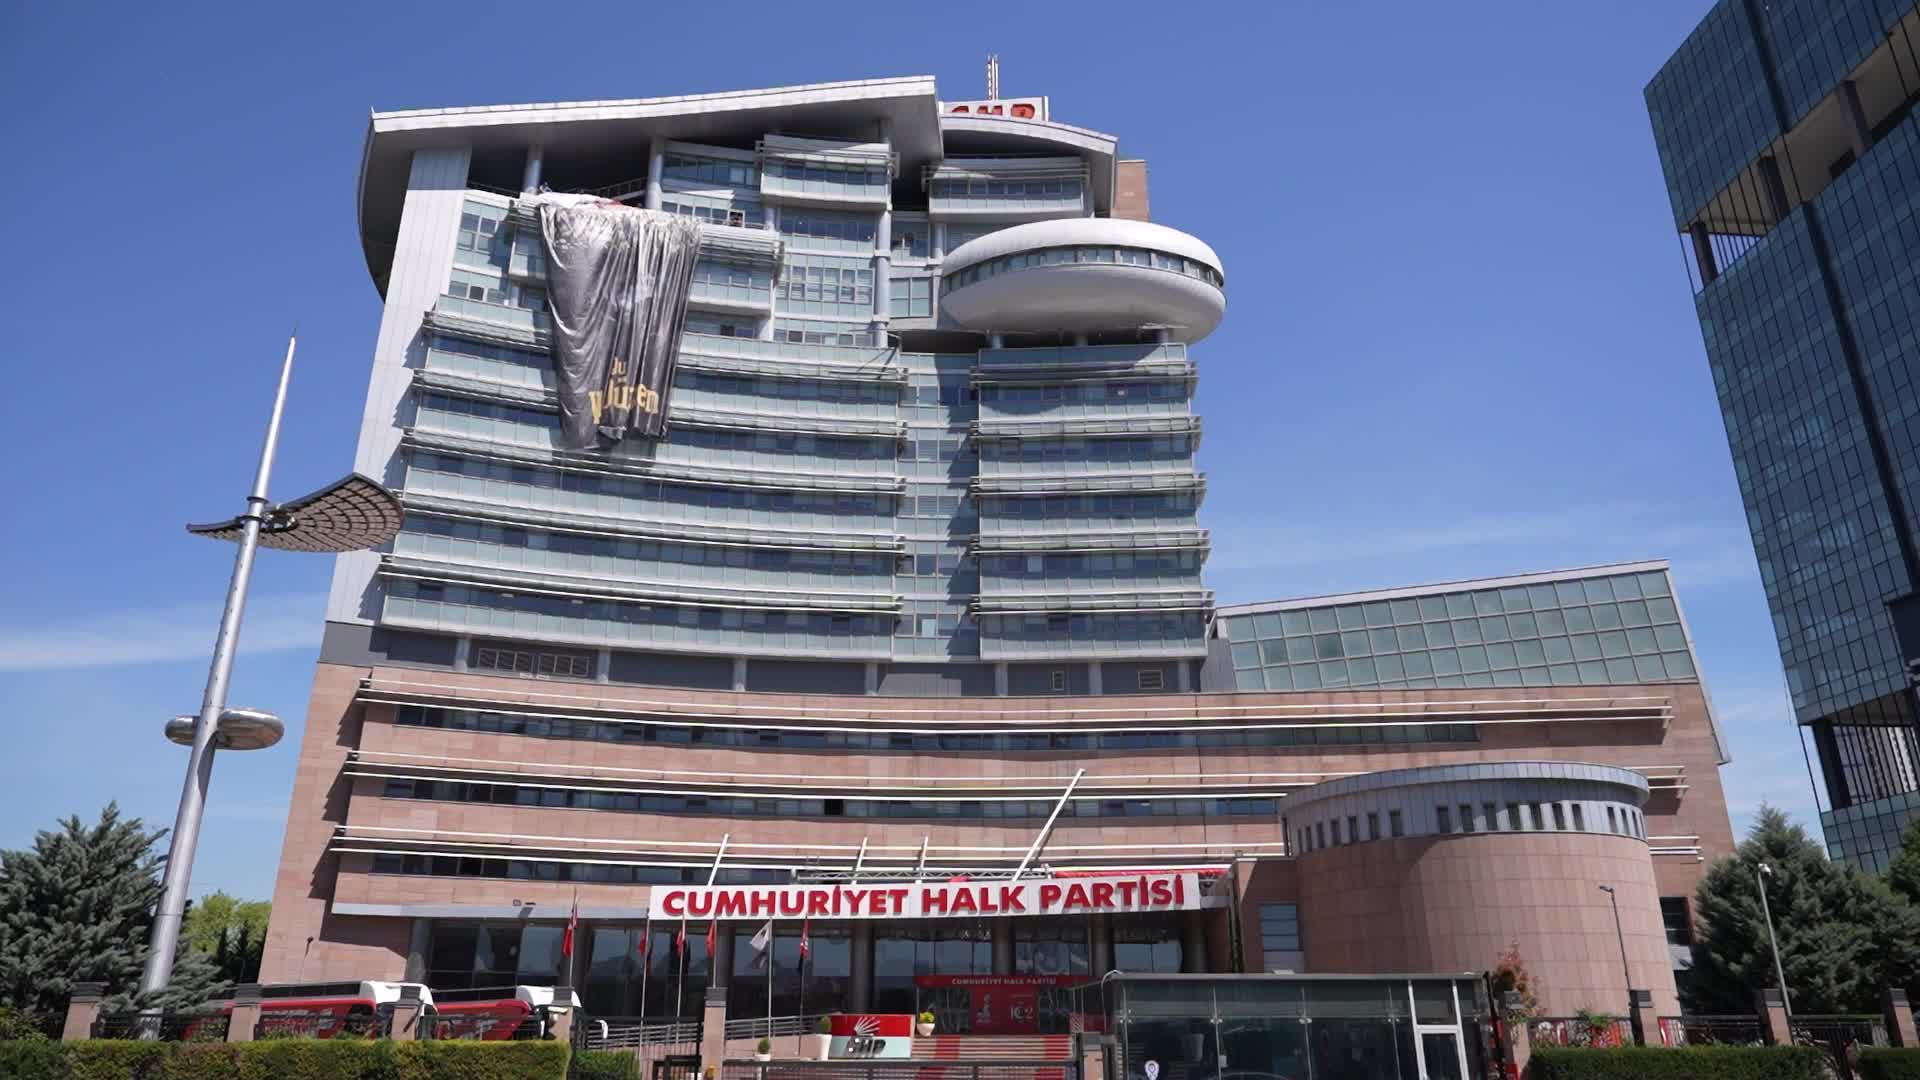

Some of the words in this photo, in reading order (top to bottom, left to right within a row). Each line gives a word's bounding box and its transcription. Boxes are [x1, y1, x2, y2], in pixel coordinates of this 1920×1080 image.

[663, 885, 909, 918] CUMHURİYET
[922, 885, 1025, 914] HALK
[1040, 874, 1185, 910] PARTİSİ
